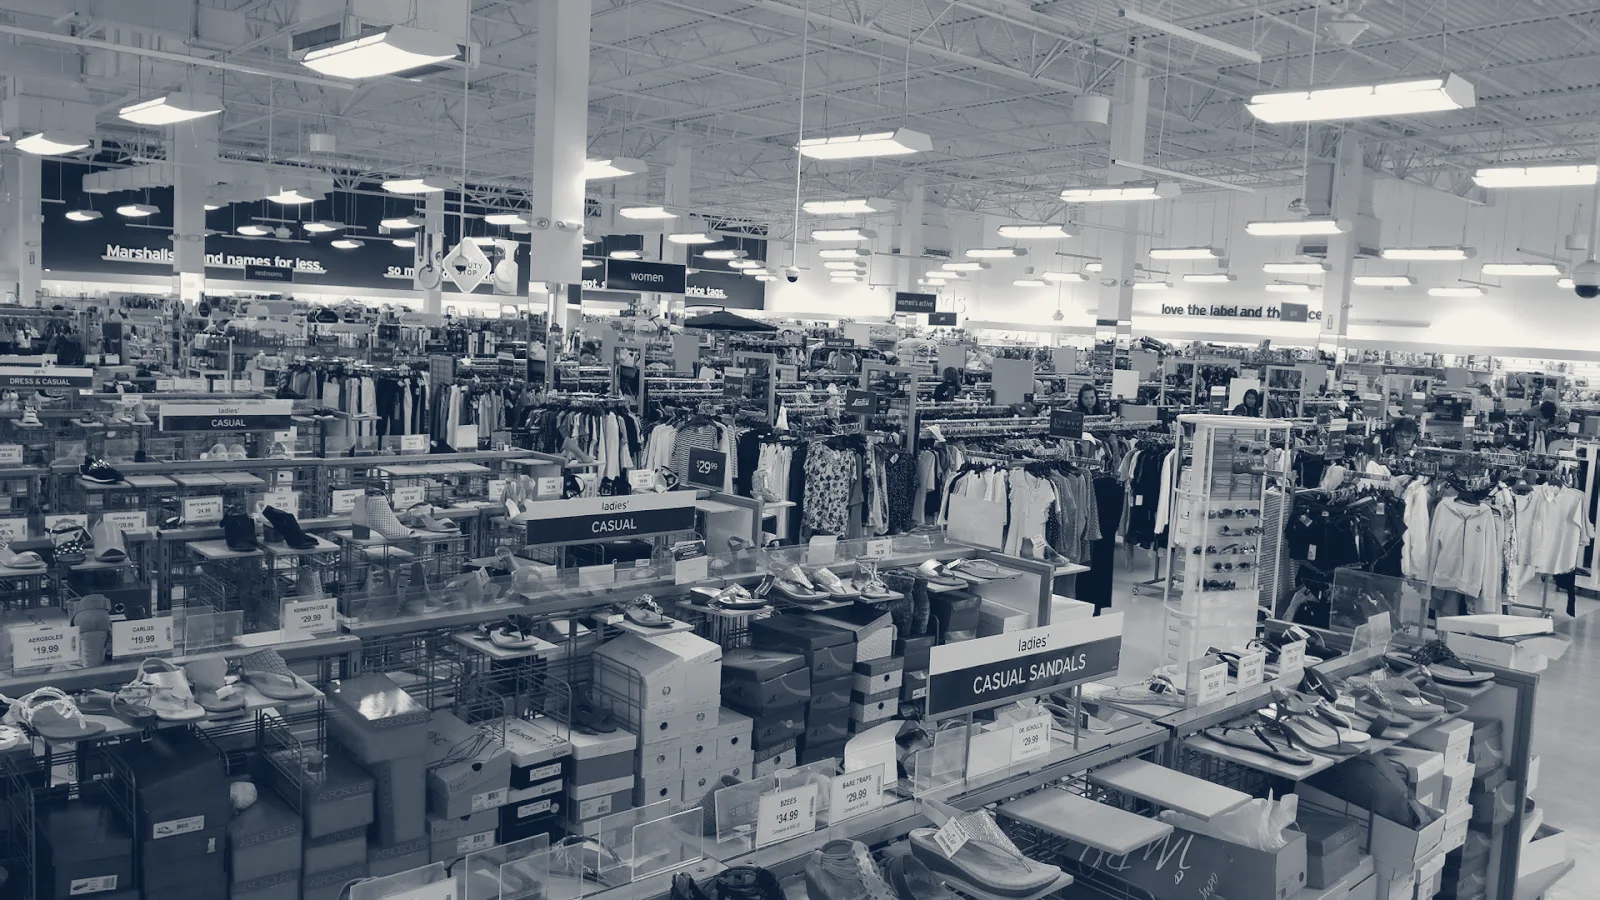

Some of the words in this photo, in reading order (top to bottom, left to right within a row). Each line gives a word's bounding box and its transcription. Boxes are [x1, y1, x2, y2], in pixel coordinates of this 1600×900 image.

[106, 244, 173, 262] Marshalls
[227, 254, 271, 267] names
[274, 256, 292, 268] for
[296, 257, 324, 270] less.
[255, 269, 283, 278] restrooms
[631, 272, 664, 283] women
[582, 279, 599, 289] ept.
[919, 300, 934, 308] active
[1161, 304, 1183, 315] love
[1187, 304, 1206, 315] the
[1210, 305, 1237, 317] label
[1240, 306, 1263, 318] and
[1267, 307, 1281, 319] th
[9, 377, 35, 385] DRESS
[42, 378, 70, 386] CASUAL
[211, 418, 246, 427] CASUAL
[601, 501, 629, 511] ladies'
[591, 518, 637, 533] CASUAL
[294, 605, 315, 613] KENNETH
[132, 625, 155, 633] CARLOS
[28, 634, 64, 643] AEROSOLES
[1018, 634, 1050, 652] ladies'
[33, 644, 59, 654] $19.99
[973, 667, 1026, 694] CASUAL
[1029, 653, 1086, 681] SANDALS
[842, 779, 856, 789] BARE
[856, 774, 872, 785] TRAPS
[317, 781, 371, 801] AEROSOLES
[780, 796, 797, 807] BZEES
[239, 823, 296, 848] AEROSOLES
